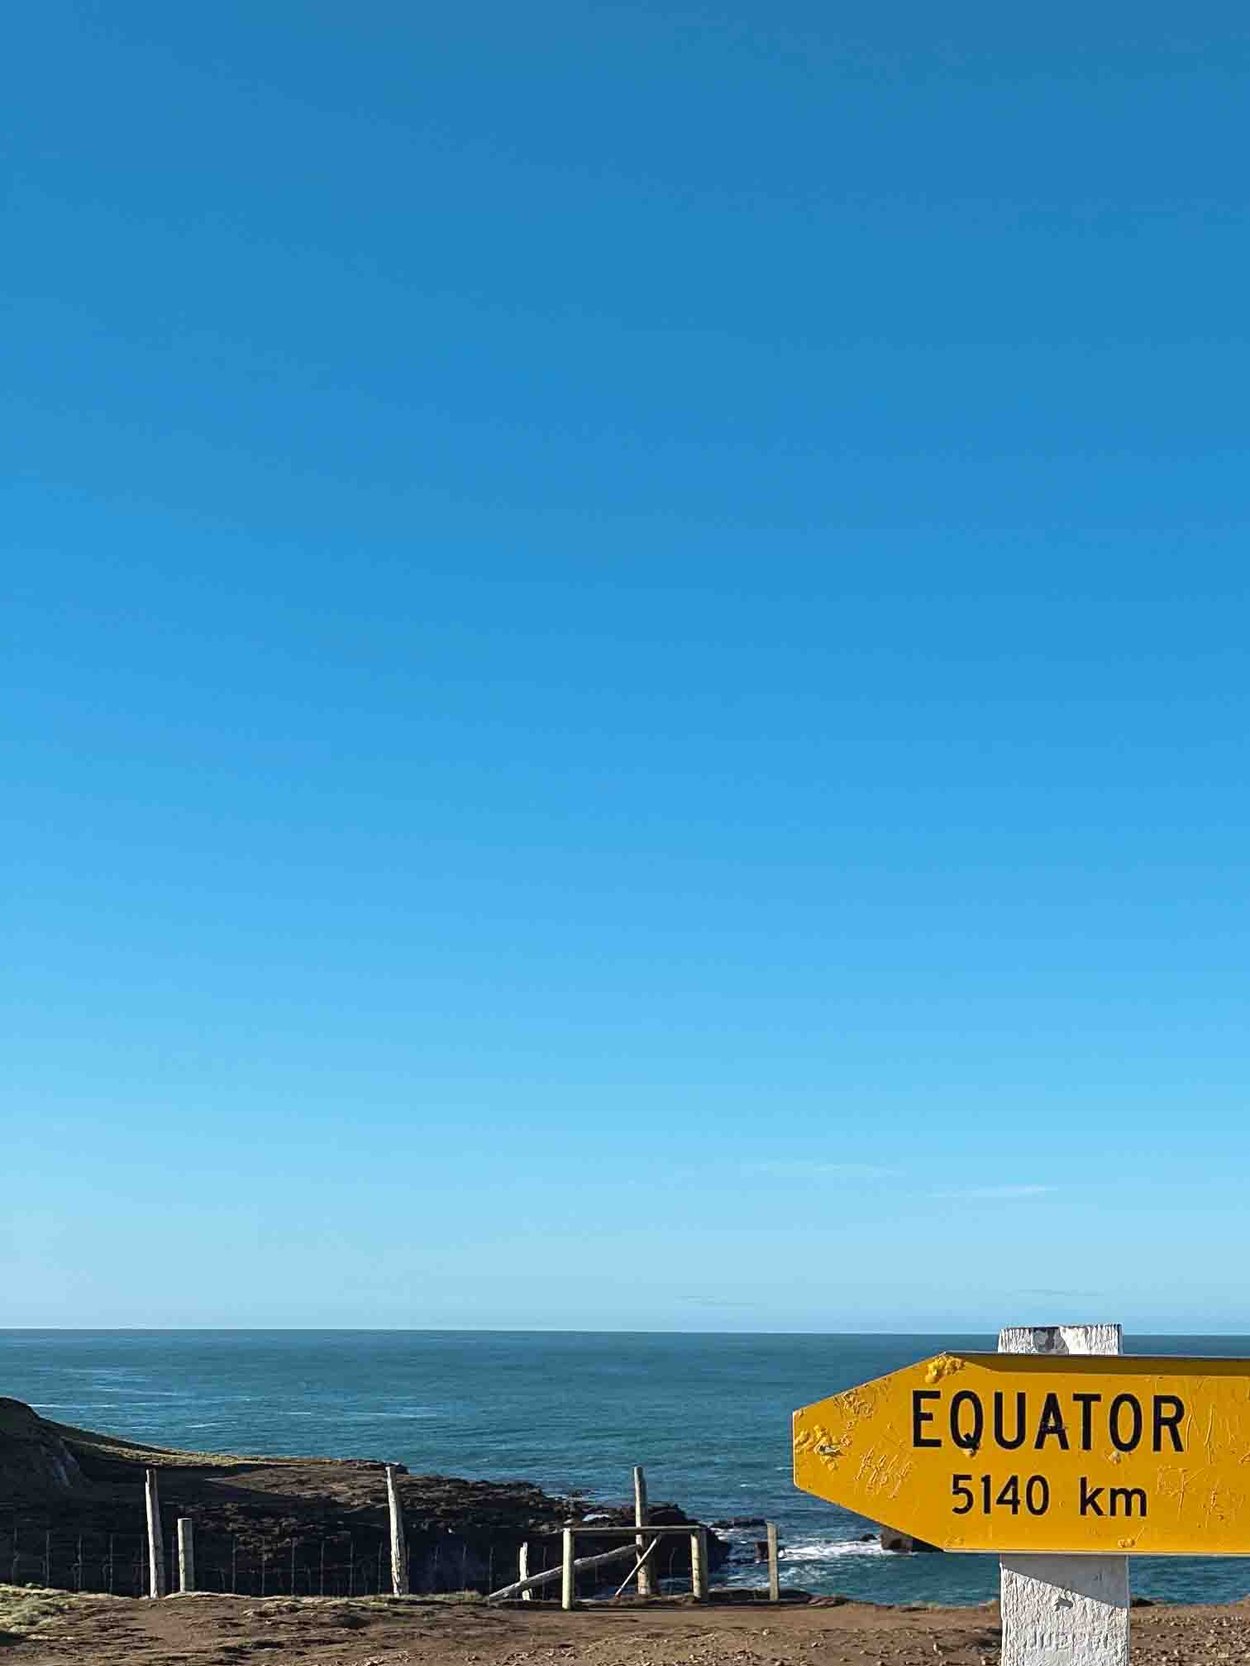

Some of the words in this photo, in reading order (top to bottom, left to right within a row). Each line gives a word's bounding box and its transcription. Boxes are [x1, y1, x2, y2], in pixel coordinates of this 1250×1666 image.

[912, 1389, 1185, 1454] EQUATOR
[952, 1474, 1050, 1516] 5140
[1079, 1476, 1148, 1517] km
